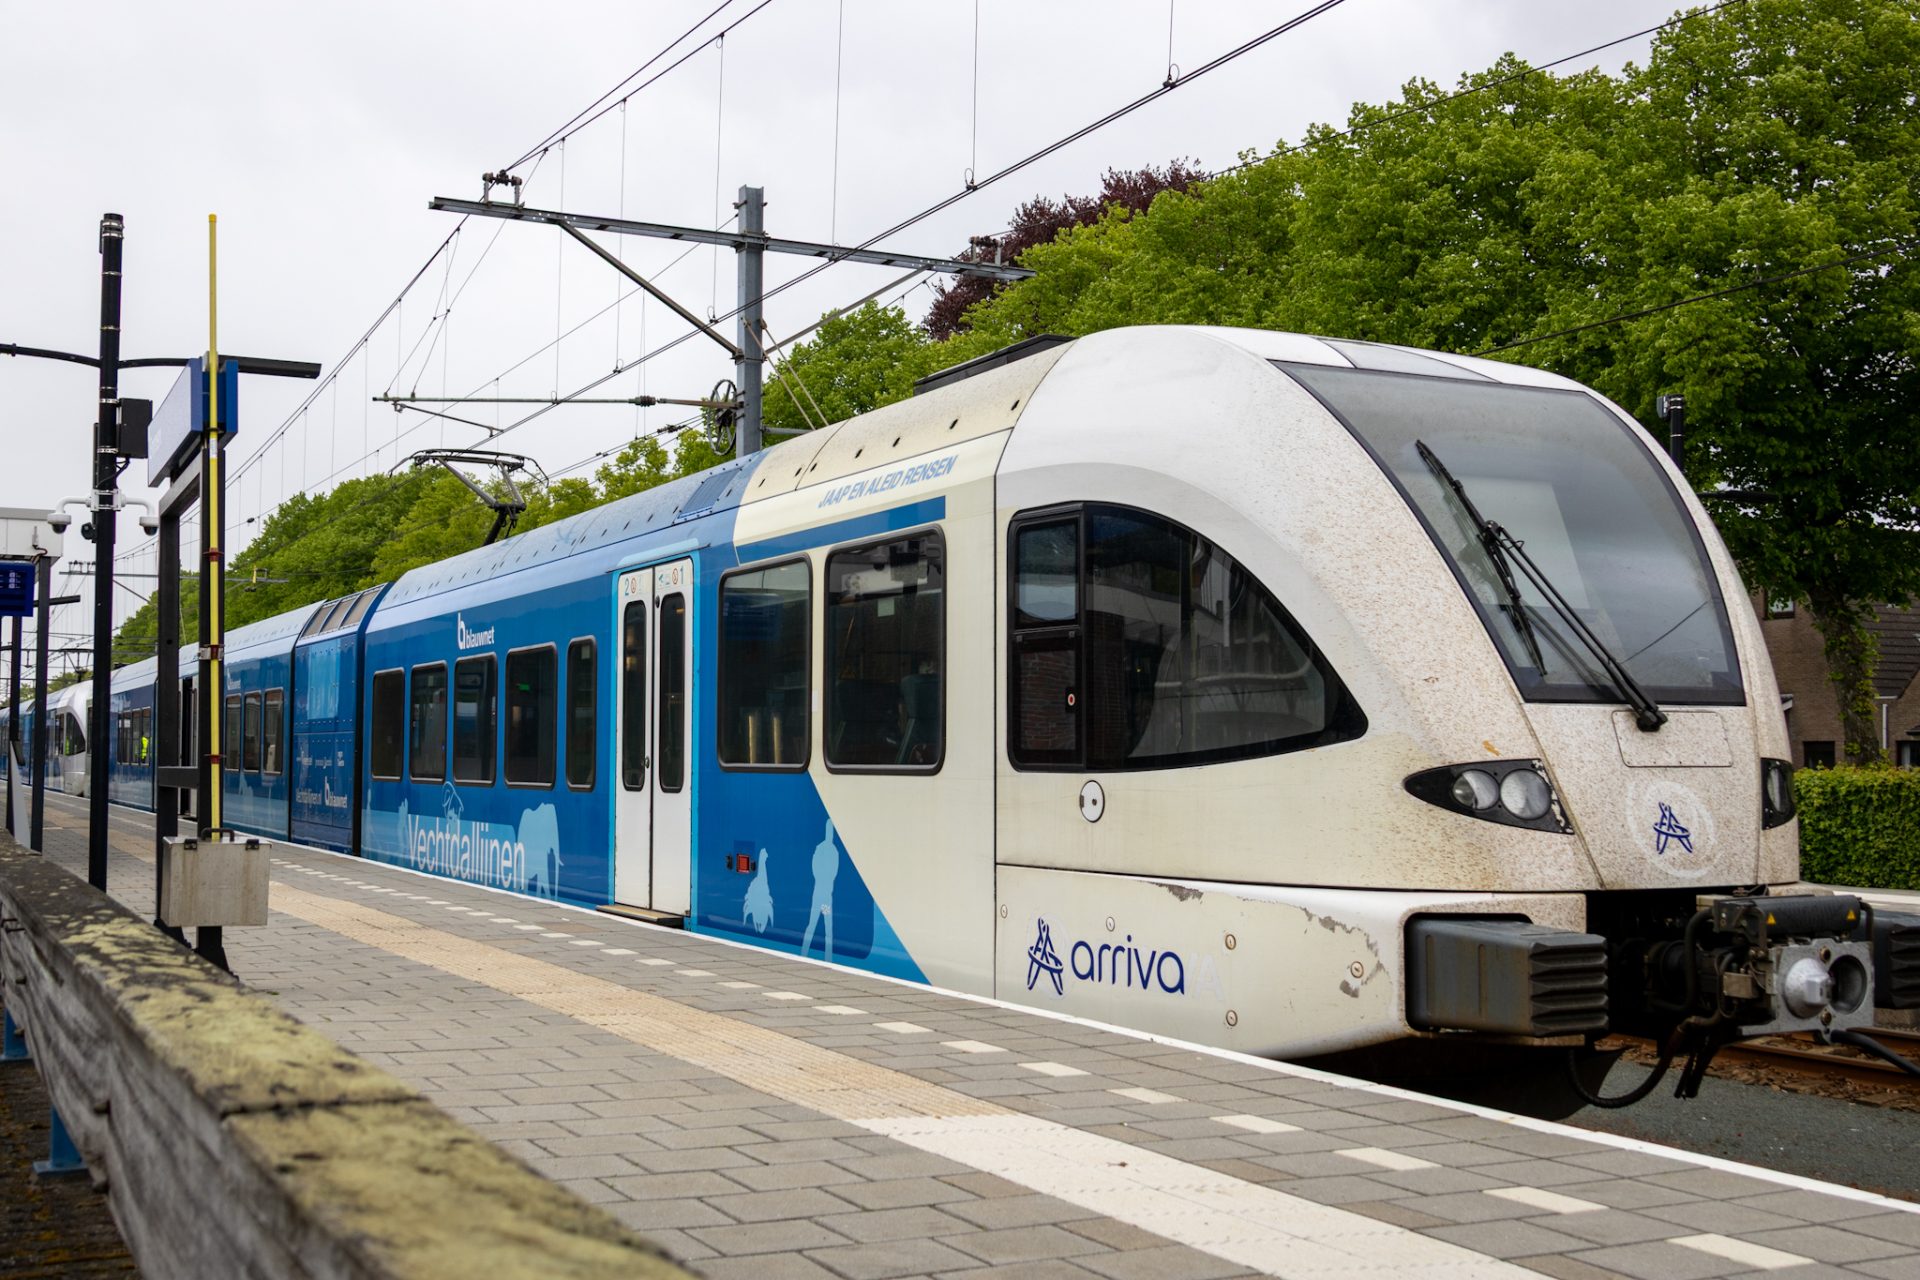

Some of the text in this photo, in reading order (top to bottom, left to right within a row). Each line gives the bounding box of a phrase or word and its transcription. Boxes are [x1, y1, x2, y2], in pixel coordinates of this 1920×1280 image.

[817, 455, 959, 508] JAAP EN ALEID RENSEN
[466, 626, 495, 649] blauwnet
[408, 813, 525, 890] Vechtdallijnen
[1071, 934, 1185, 995] arriva
